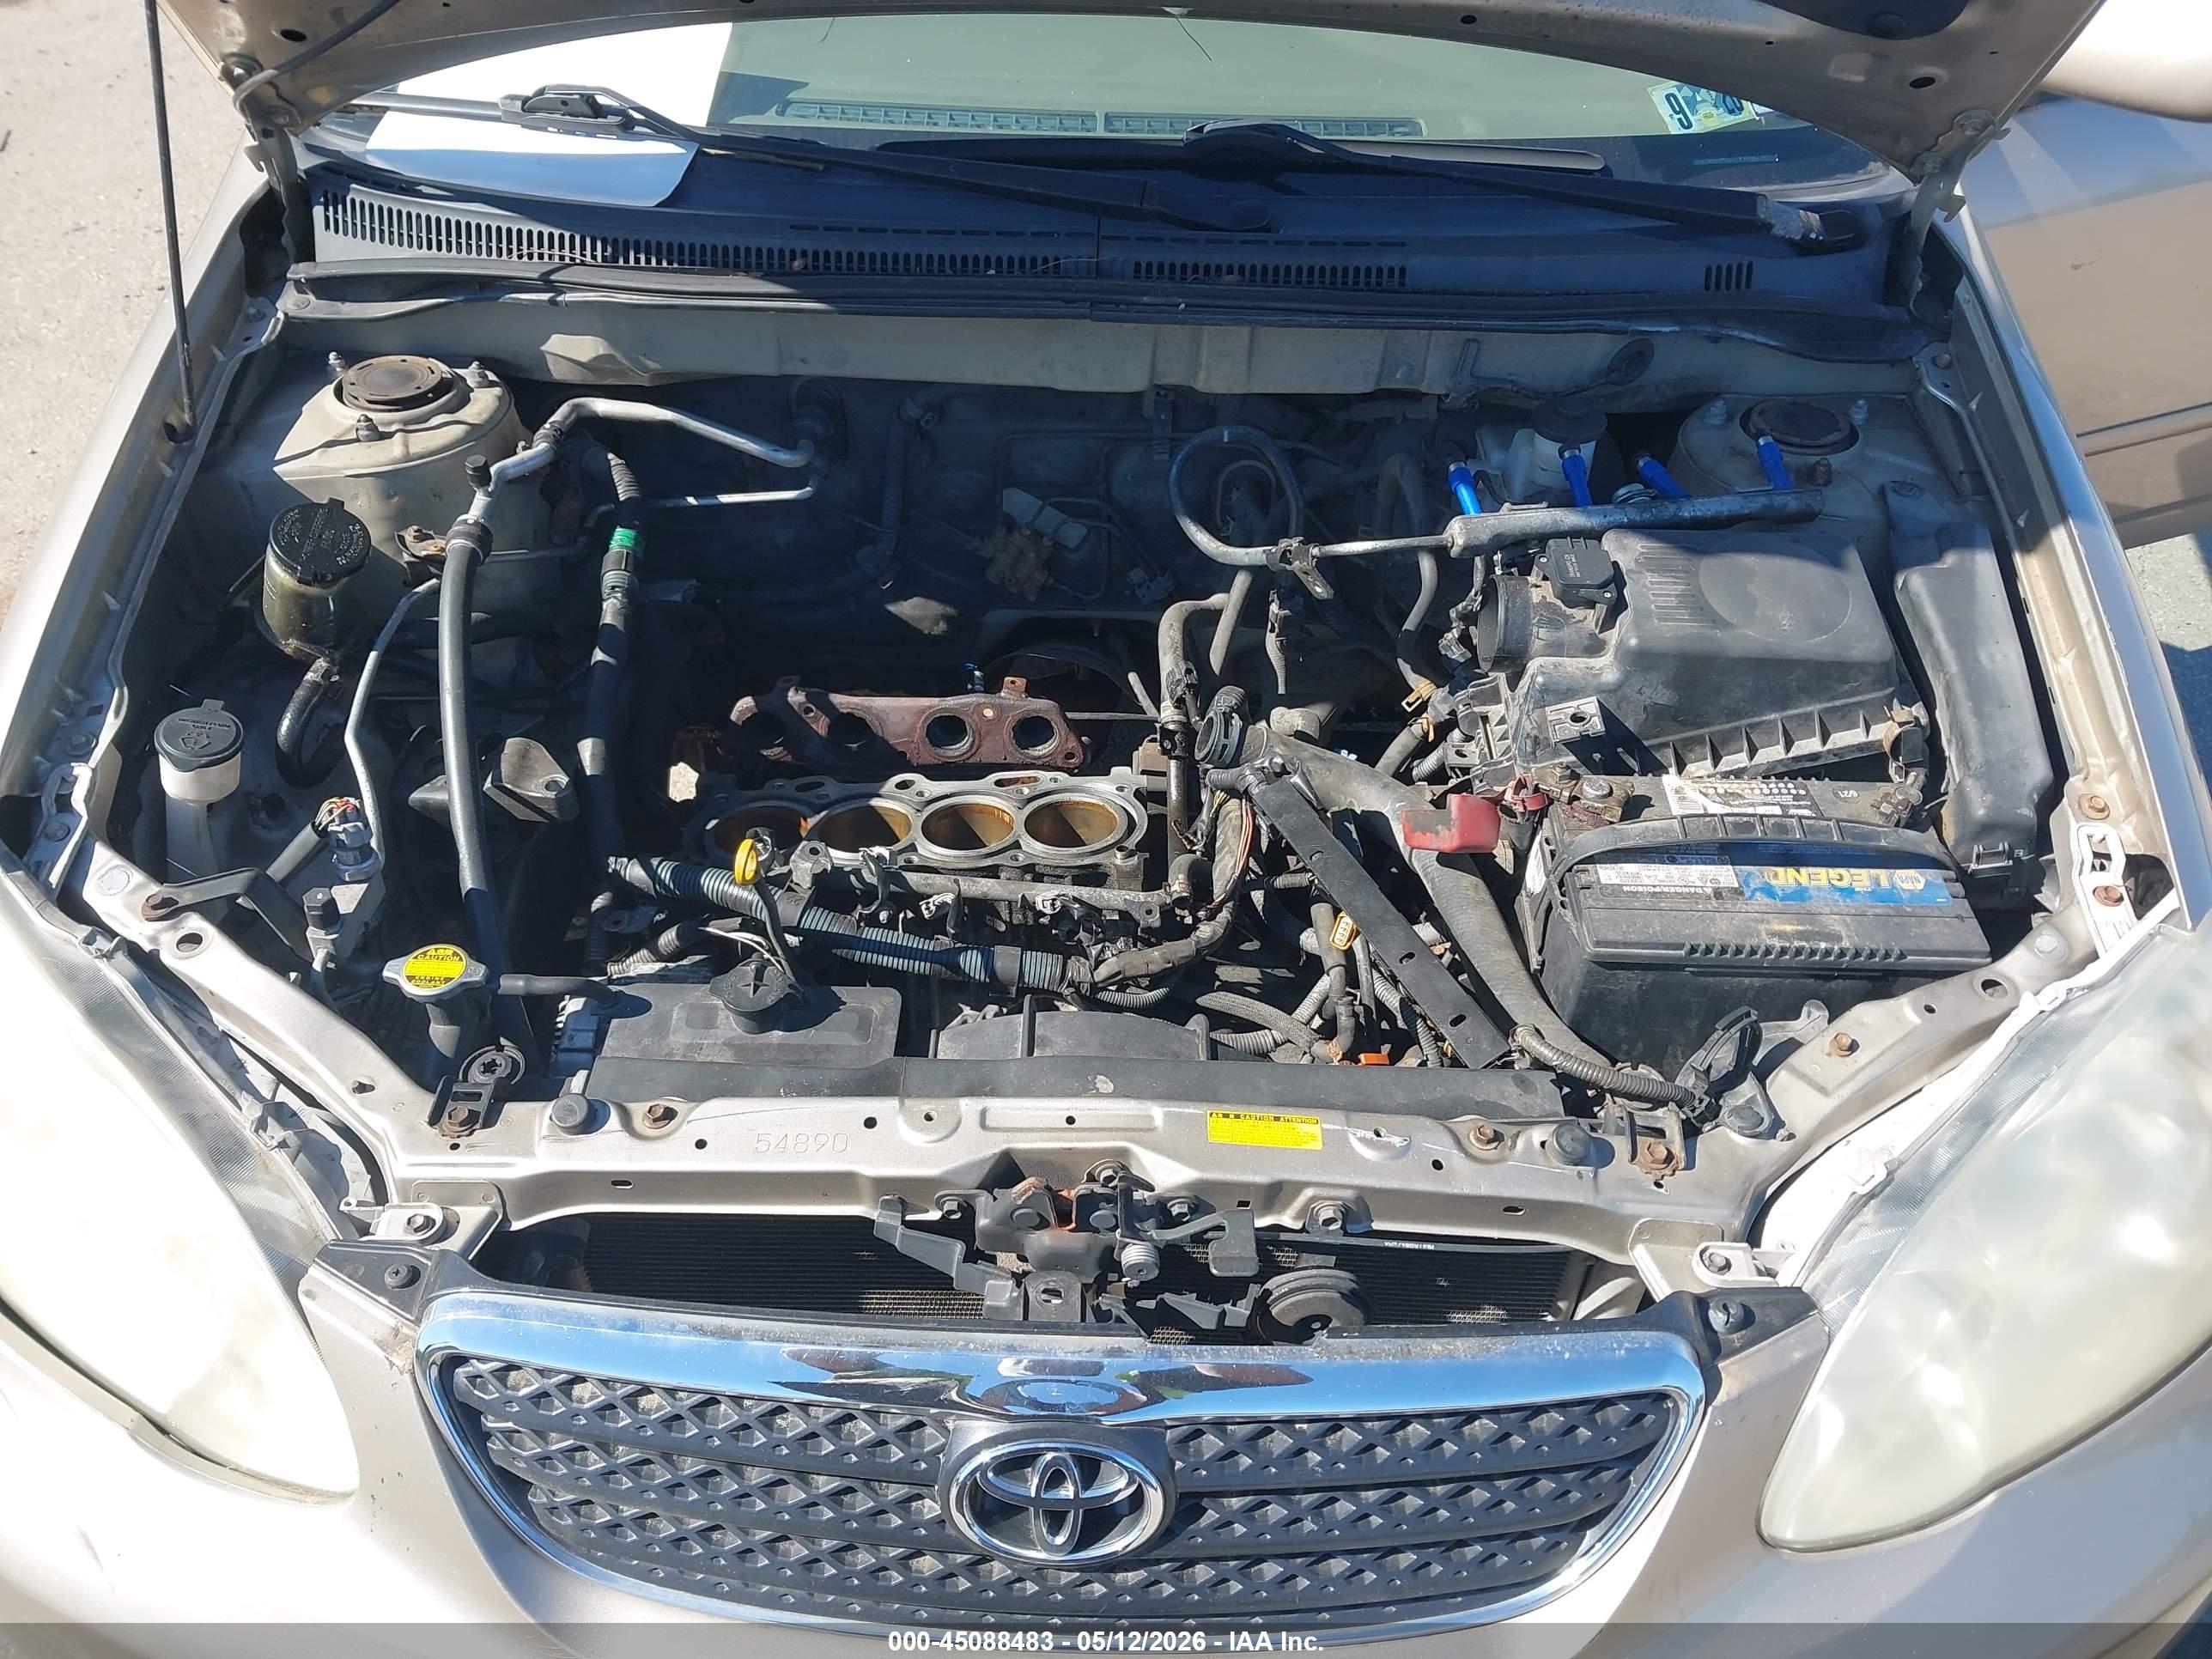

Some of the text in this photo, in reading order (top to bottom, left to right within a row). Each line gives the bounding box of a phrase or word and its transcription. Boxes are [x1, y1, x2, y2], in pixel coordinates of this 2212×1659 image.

[1763, 866, 1891, 889] LEGEND
[1898, 872, 1922, 888] NAPA
[1279, 1115, 1317, 1124] ATTENTION
[756, 1132, 849, 1154] 54890
